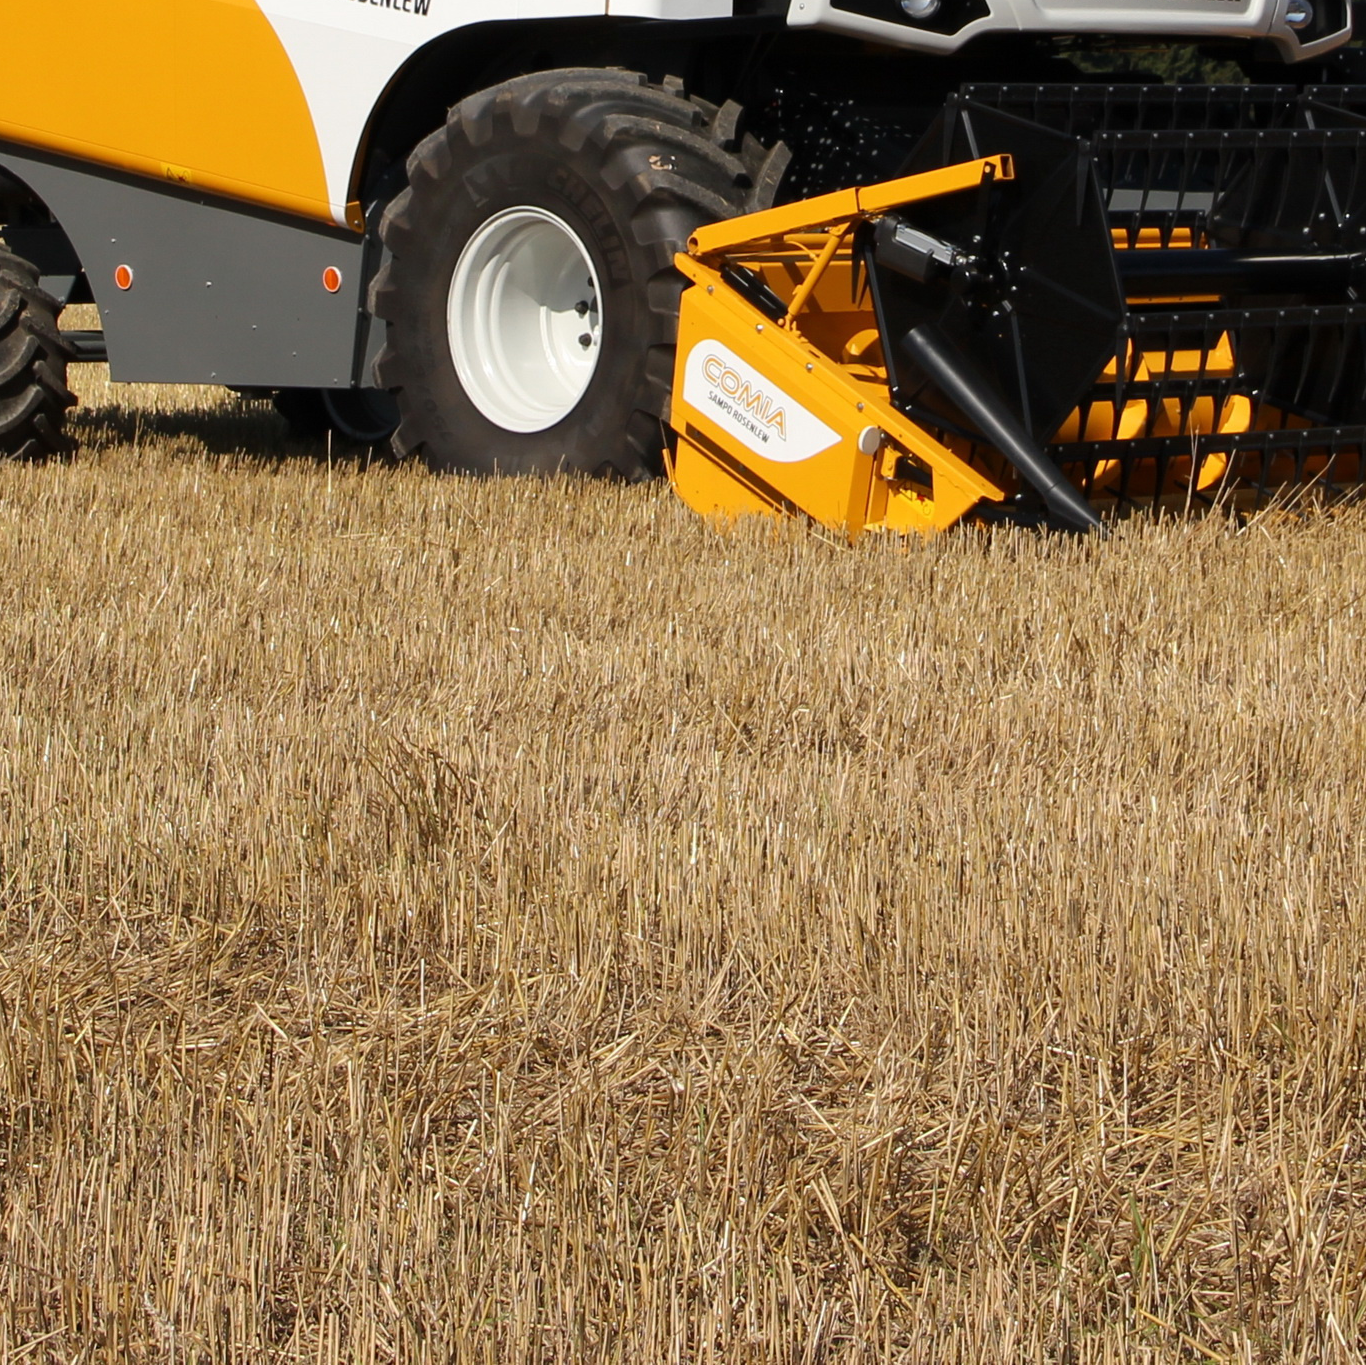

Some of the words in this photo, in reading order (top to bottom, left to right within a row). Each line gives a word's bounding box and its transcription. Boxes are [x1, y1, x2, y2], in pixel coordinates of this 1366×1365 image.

[701, 353, 788, 443] COMIA
[707, 390, 734, 415] SAMPO
[732, 409, 771, 444] ROSENLEW
